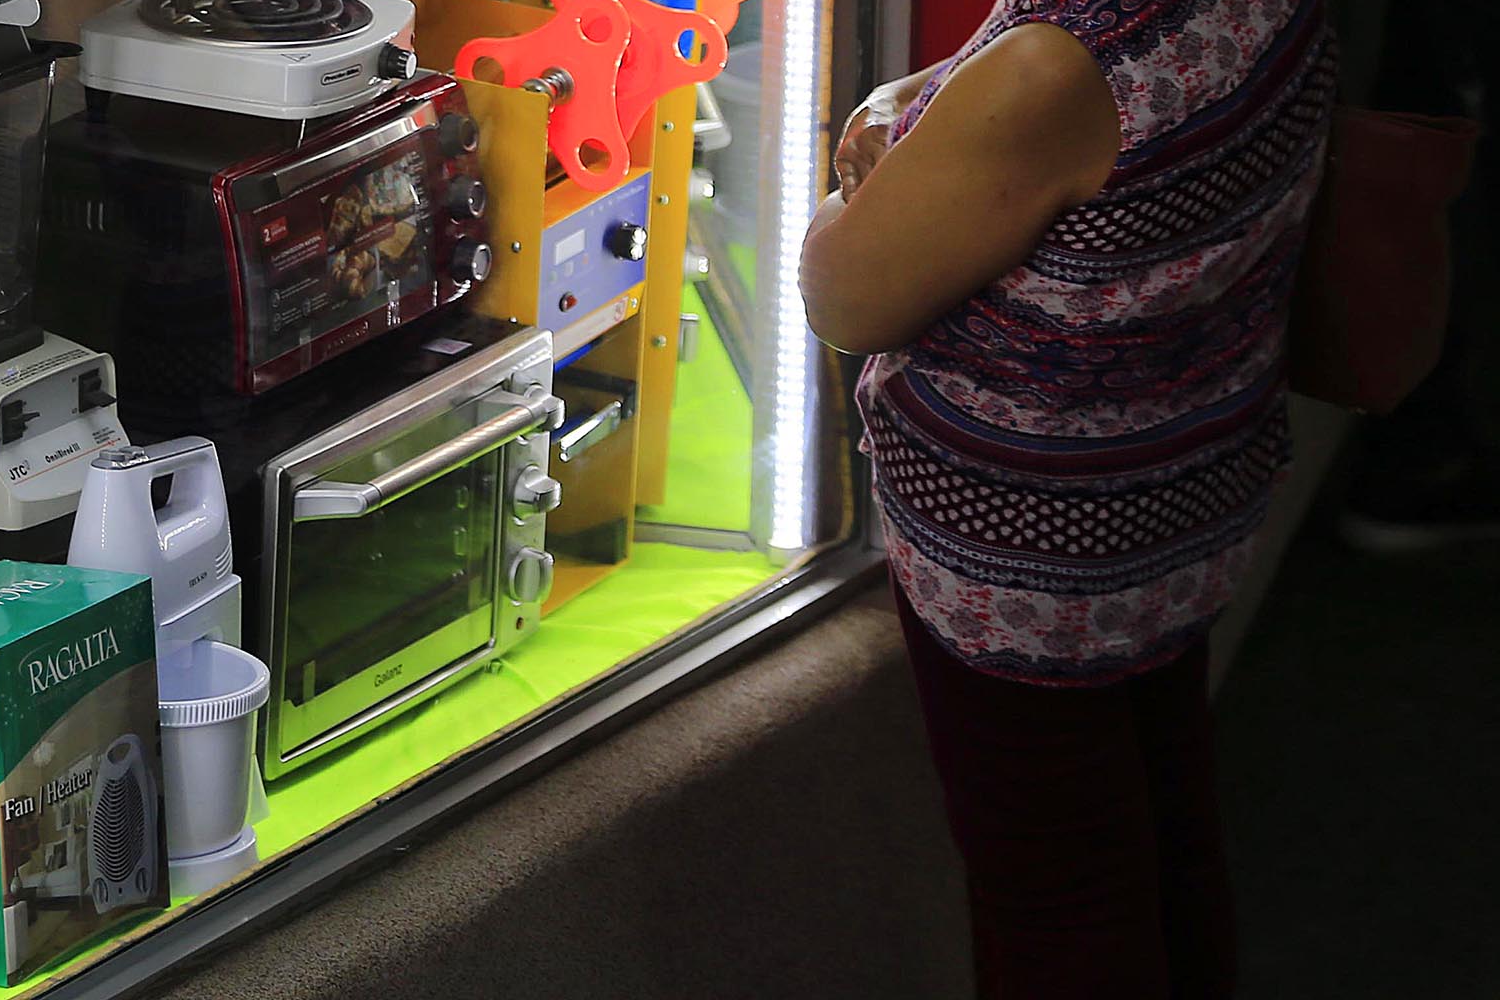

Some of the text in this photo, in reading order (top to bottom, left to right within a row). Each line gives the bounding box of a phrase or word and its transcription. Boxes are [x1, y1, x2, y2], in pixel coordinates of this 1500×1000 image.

[9, 464, 28, 481] JTC
[27, 626, 122, 696] RAGALTA
[3, 795, 36, 823] Fan
[46, 767, 94, 803] Heater
